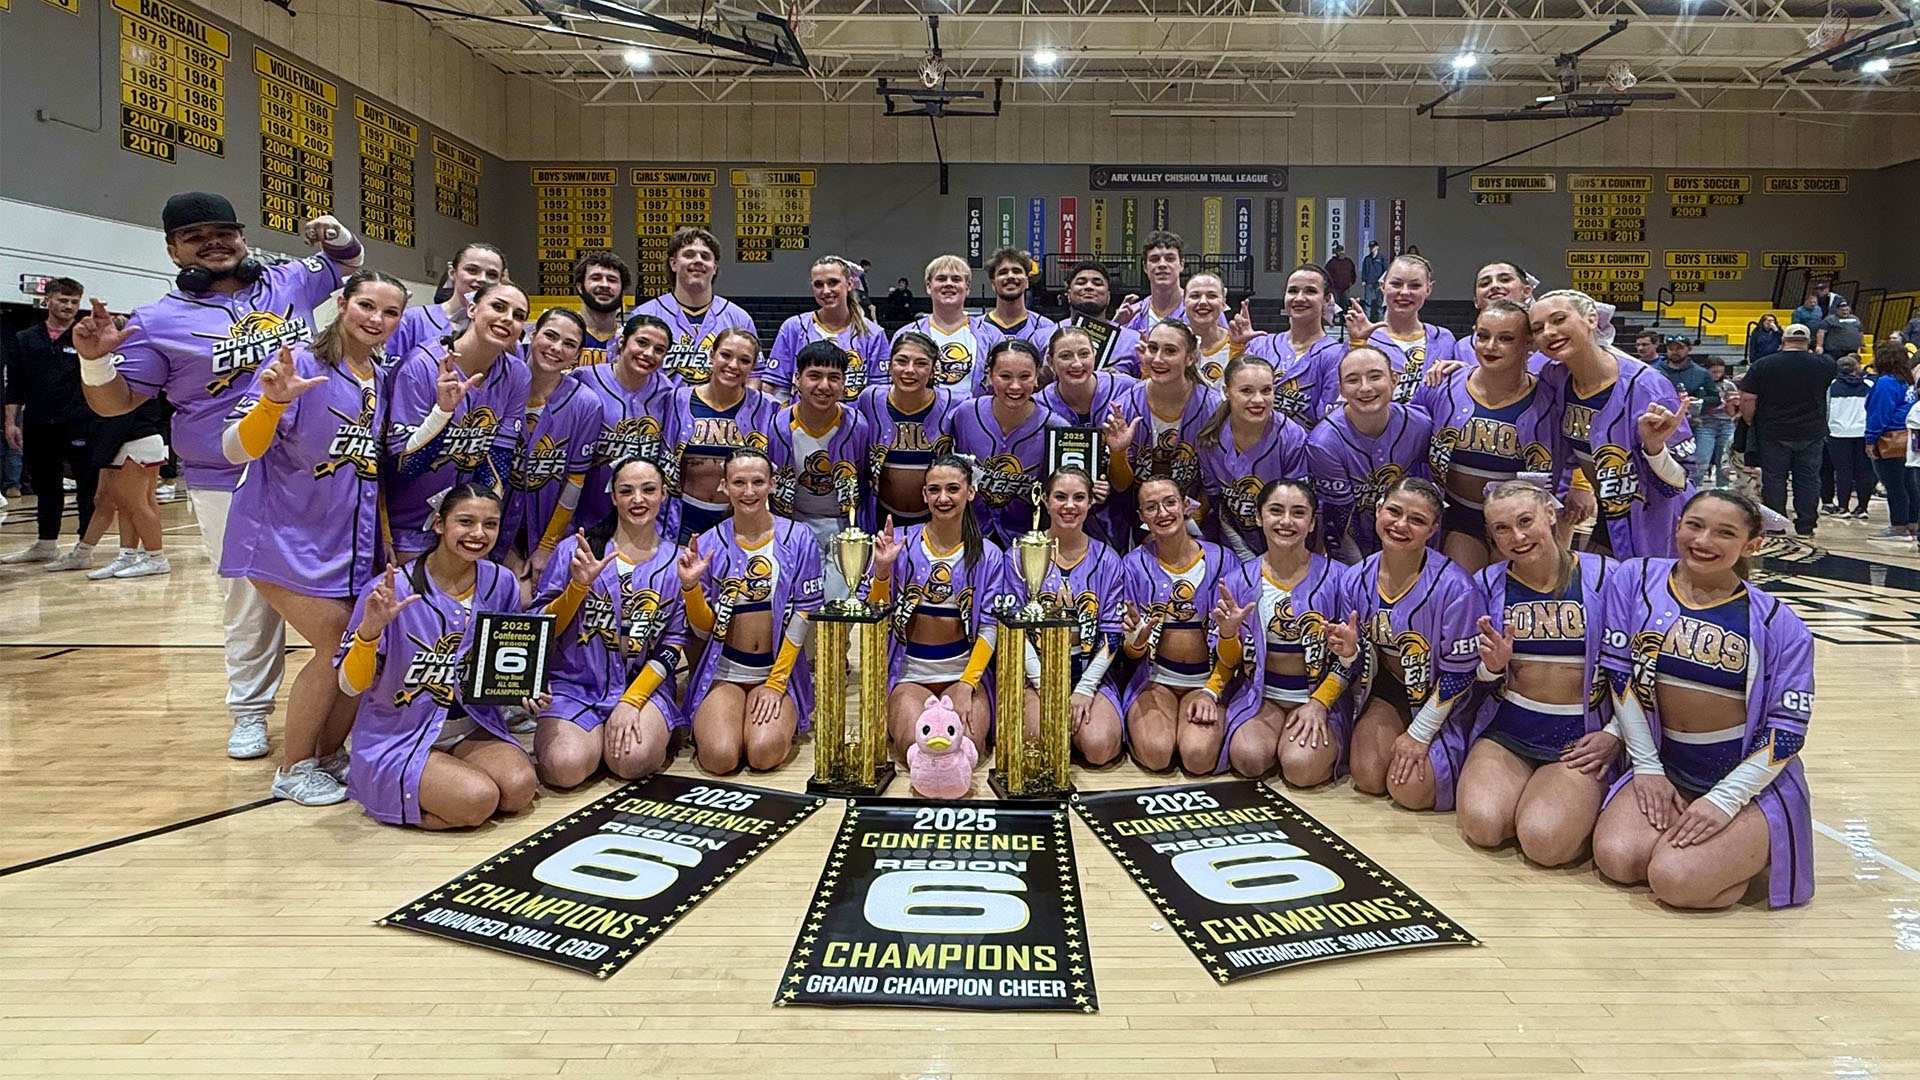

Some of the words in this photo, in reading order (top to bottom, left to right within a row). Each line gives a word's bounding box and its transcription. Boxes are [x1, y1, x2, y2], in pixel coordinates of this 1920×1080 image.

[141, 0, 208, 44] BASEBALL
[130, 22, 167, 46] 1978
[184, 47, 217, 72] 1982
[131, 67, 167, 92] 1985
[184, 67, 217, 92] 1984
[270, 59, 325, 97] VOLLEYBALL
[131, 89, 168, 114] 1987
[184, 88, 217, 111] 1986
[267, 83, 292, 104] 1979
[267, 102, 292, 122] 1982
[305, 100, 328, 119] 1980
[130, 111, 168, 136] 2007
[184, 109, 217, 132] 1989
[305, 118, 328, 136] 1983
[267, 120, 292, 140] 1984
[365, 126, 384, 144] 1992
[130, 134, 168, 158] 2010
[184, 130, 218, 153] 2009
[266, 139, 293, 159] 2004
[304, 135, 328, 154] 2002
[365, 143, 384, 159] 1995
[267, 158, 294, 177] 2006
[304, 153, 329, 171] 2005
[364, 159, 384, 175] 2007
[304, 171, 329, 188] 2007
[563, 172, 610, 181] SWIM/DIVE
[664, 172, 711, 182] SWIM/DIVE
[746, 173, 801, 183] STLING
[1111, 173, 1129, 182] ARK
[1131, 173, 1162, 182] VALLEY
[1165, 173, 1208, 182] CHISHOLM
[1210, 174, 1234, 183] TRAIL
[1236, 174, 1268, 183] LEAGUE
[1505, 178, 1547, 188] BOWLING
[1600, 179, 1607, 187] X
[1608, 179, 1646, 188] COUNTRY
[1703, 179, 1740, 189] SOCCER
[1804, 180, 1840, 190] SOCCER
[268, 177, 292, 195] 2011
[643, 188, 668, 197] 1985
[680, 188, 705, 197] 1986
[266, 195, 295, 214] 2016
[304, 188, 330, 206] 2015
[365, 191, 384, 207] 2011
[643, 201, 668, 209] 1987
[680, 201, 705, 209] 1989
[1616, 195, 1641, 203] 1982
[1677, 195, 1701, 204] 1997
[1712, 195, 1740, 204] 2005
[365, 207, 384, 222] 2013
[581, 213, 606, 222] 1997
[680, 214, 705, 222] 1992
[742, 214, 767, 222] 1972
[780, 214, 804, 222] 1973
[1301, 205, 1310, 228] ARK
[1579, 207, 1604, 215] 1983
[1615, 207, 1641, 215] 2000
[1675, 208, 1702, 216] 2009
[269, 213, 293, 231] 2018
[366, 222, 384, 240] 2019
[581, 226, 606, 234] 1999
[742, 226, 767, 234] 1977
[779, 227, 803, 235] 2012
[1614, 219, 1641, 228] 2005
[970, 210, 980, 257] CAMPUS
[1063, 214, 1074, 253] MAIZE
[1239, 207, 1248, 262] ANDOVER
[1331, 208, 1341, 257] GODDA
[1577, 232, 1604, 241] 2015
[1615, 230, 1640, 242] 2019
[543, 238, 569, 246] 2002
[642, 238, 668, 247] 2006
[780, 238, 804, 249] 2020
[1301, 234, 1309, 265] CITY
[742, 251, 767, 260] 2022
[1599, 254, 1605, 263] X
[1607, 254, 1646, 264] COUNTRY
[1705, 254, 1738, 264] TENNIS
[1804, 255, 1837, 266] TENNIS
[544, 263, 570, 271] 2006
[1578, 271, 1603, 279] 1977
[1615, 271, 1640, 279] 1979
[1676, 271, 1701, 279] 1978
[1712, 271, 1738, 279] 1987
[1614, 282, 1639, 291] 2005
[1674, 283, 1699, 292] 2012
[276, 316, 305, 335] CITY
[501, 622, 530, 630] 2025
[493, 631, 536, 641] Conference
[495, 647, 528, 673] 6
[485, 688, 530, 696] CHAMPIONS
[674, 786, 762, 812] 2025
[1136, 791, 1221, 816] 2025
[613, 798, 774, 836] CONFERENCE
[913, 808, 997, 831] 2025
[1112, 805, 1284, 838] CONFERENCE
[598, 821, 729, 852] REGION
[860, 832, 1047, 851] CONFERENCE
[1150, 828, 1290, 855] REGION
[532, 833, 703, 901] 6
[873, 859, 1027, 872] REGION
[1170, 842, 1346, 905] 6
[451, 881, 650, 941] CHAMPIONS
[863, 870, 1030, 935] 6
[1200, 896, 1414, 945] CHAMPIONS
[418, 907, 510, 938] ADVANCED
[499, 922, 557, 951] SMALL
[556, 937, 610, 962] COED
[1224, 936, 1347, 968] INTERMEDIATE
[1345, 930, 1394, 952] SMALL
[1392, 924, 1440, 945] COED
[821, 942, 1058, 972] CHAMPIONS
[805, 975, 879, 994] GRAND
[882, 976, 993, 997] CHAMPION
[998, 978, 1067, 998] CHEER
